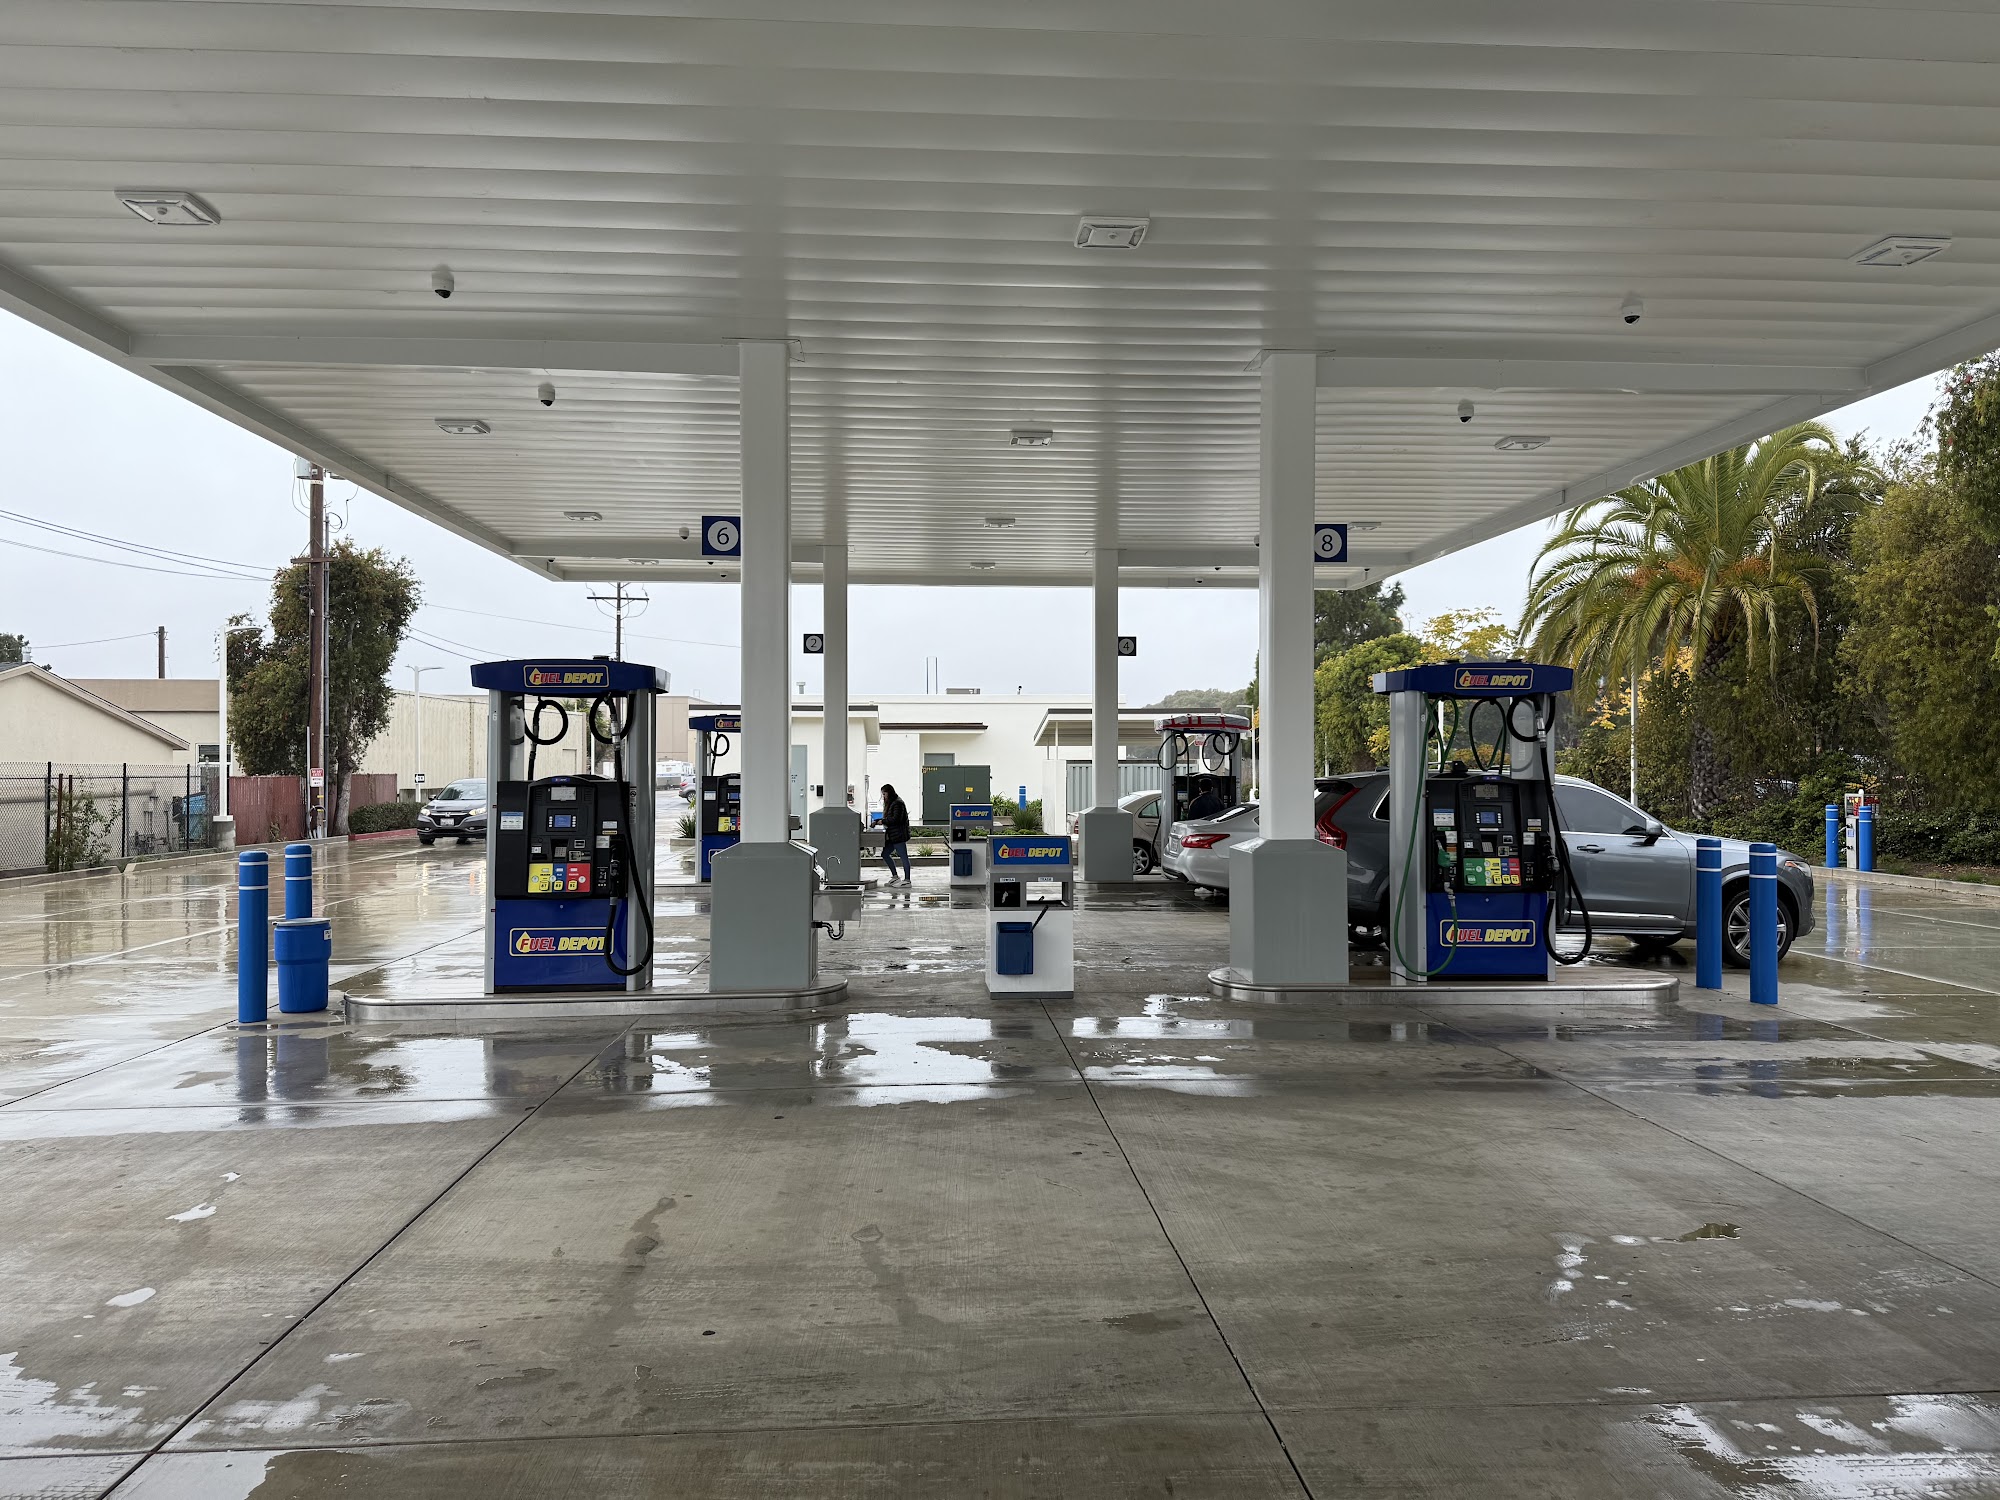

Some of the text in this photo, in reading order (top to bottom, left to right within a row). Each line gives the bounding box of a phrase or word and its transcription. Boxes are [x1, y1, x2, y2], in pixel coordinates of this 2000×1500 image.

[717, 526, 729, 544] 6
[1322, 534, 1333, 552] 8
[810, 638, 817, 648] 2
[1122, 641, 1130, 651] 4
[532, 672, 604, 684] FUEL DEPOT
[1462, 674, 1528, 686] FUEL DEPOT
[1001, 848, 1063, 858] FUEL DEPOT
[1484, 929, 1530, 942] DEPOT
[520, 938, 556, 951] FUEL
